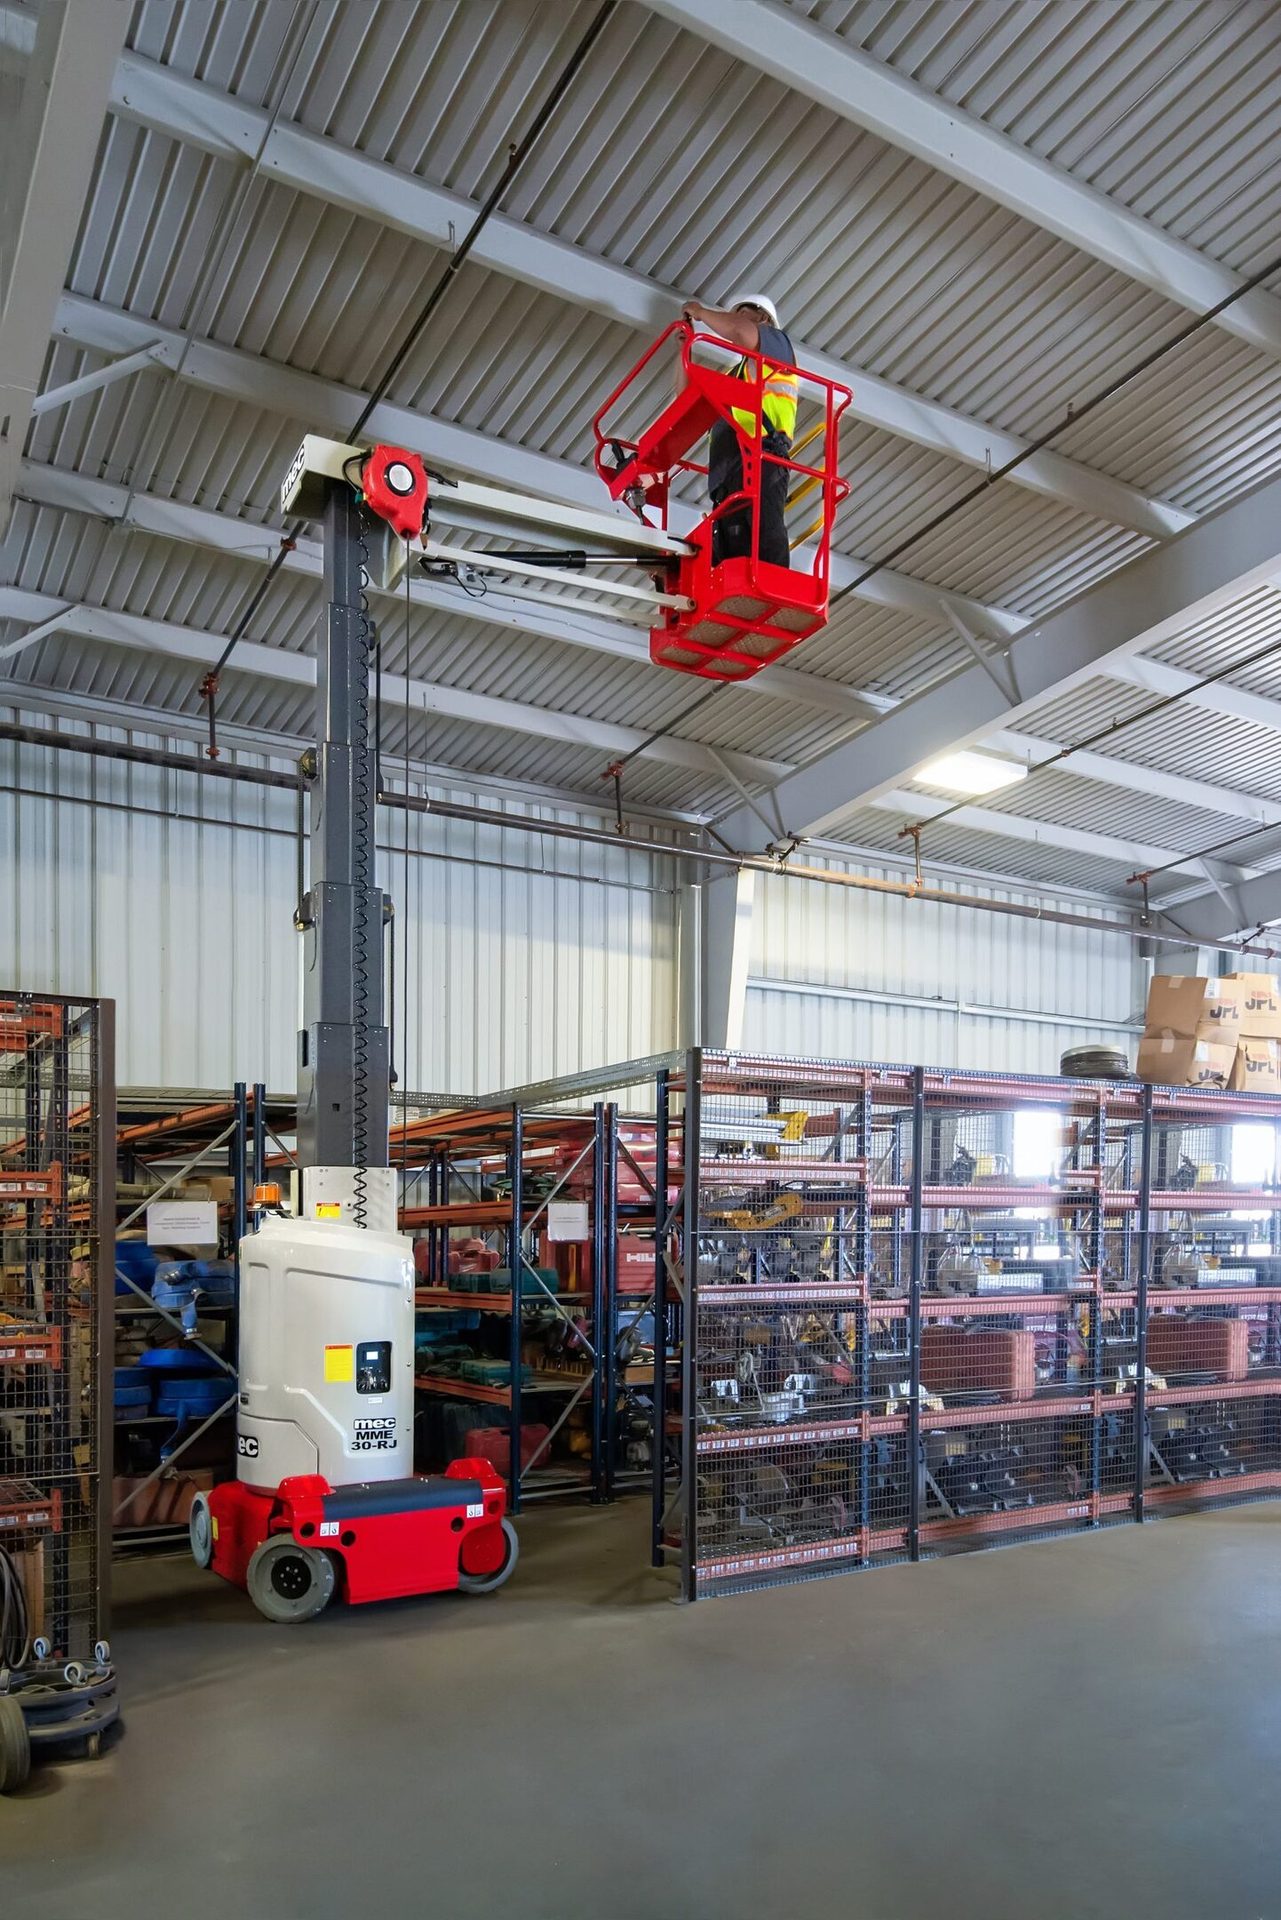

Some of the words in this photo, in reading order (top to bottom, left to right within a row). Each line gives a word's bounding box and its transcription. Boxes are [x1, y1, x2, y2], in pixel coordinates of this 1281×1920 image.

[282, 446, 304, 503] mec
[354, 1418, 396, 1430] mec
[356, 1430, 393, 1440] MME
[239, 1435, 258, 1457] ec
[351, 1440, 398, 1450] 30-RJ
